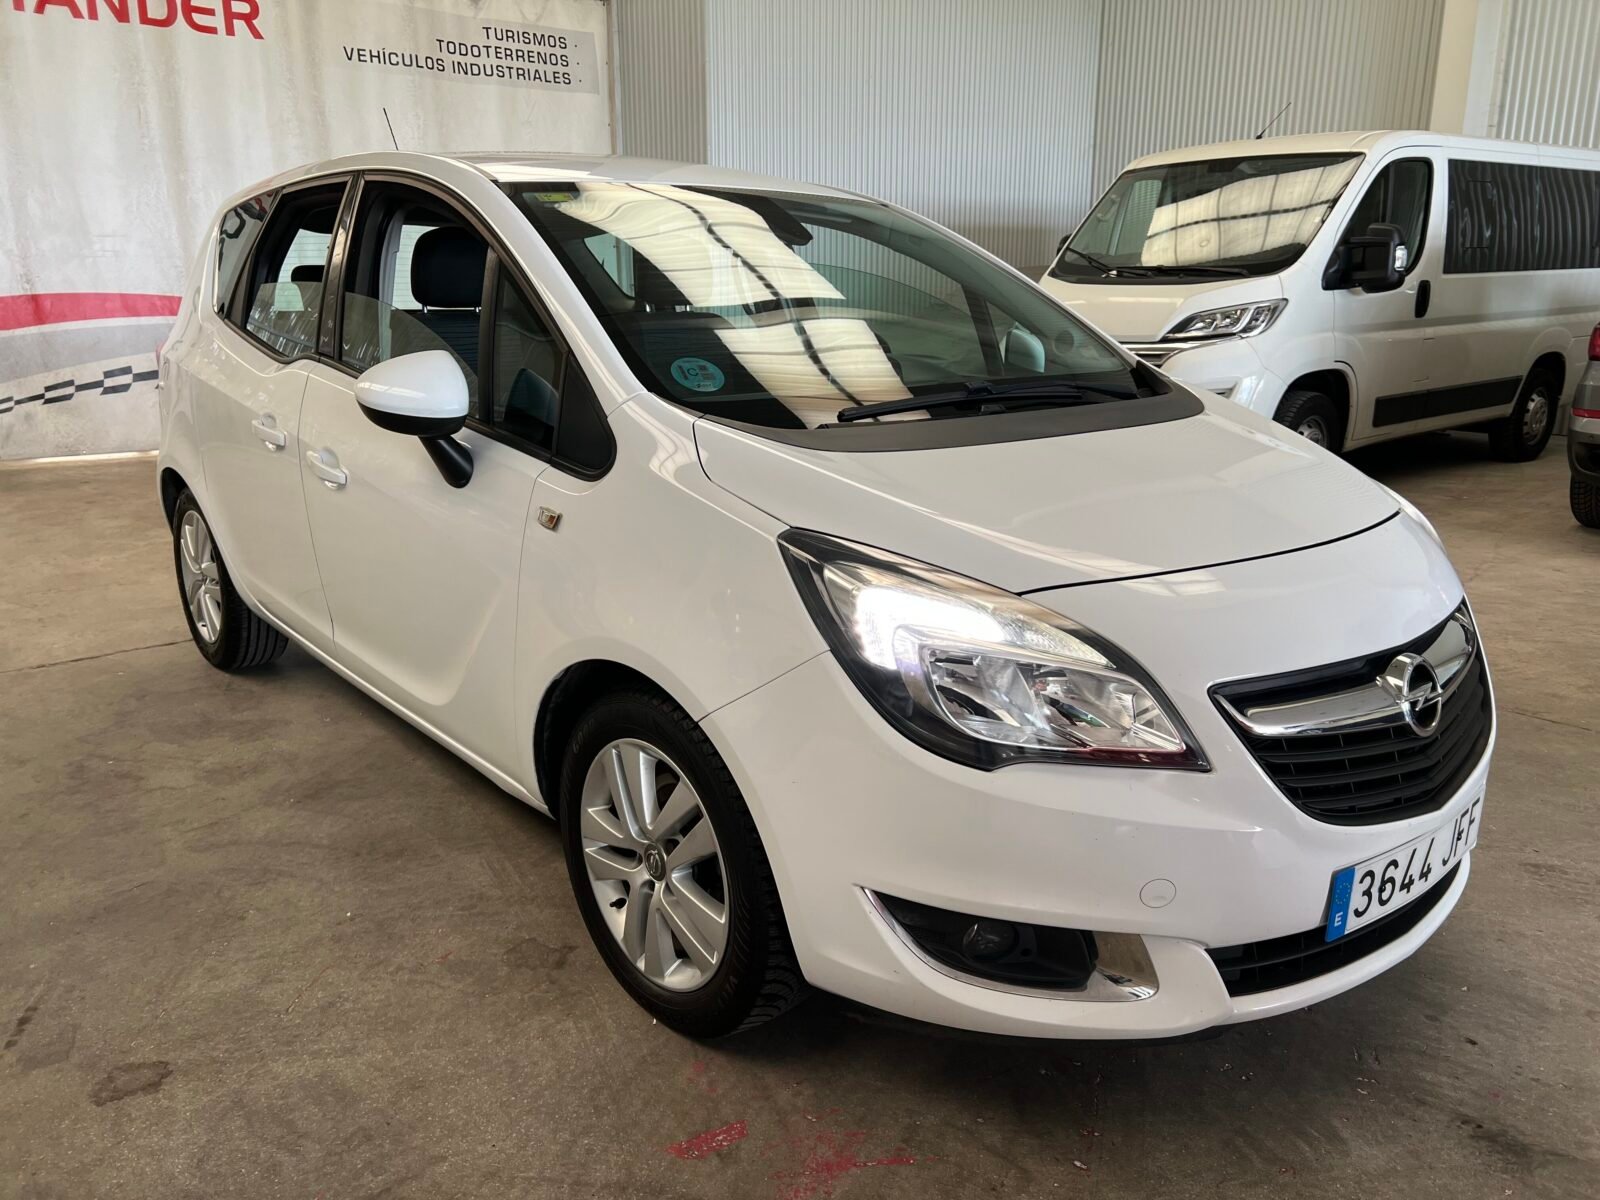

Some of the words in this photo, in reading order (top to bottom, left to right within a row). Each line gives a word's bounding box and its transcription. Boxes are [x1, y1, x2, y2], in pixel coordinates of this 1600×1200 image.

[12, 0, 265, 40] NDER
[435, 38, 570, 68] TODOTERRENOS
[482, 26, 568, 50] TURISMOS
[343, 46, 446, 72] VEHÍCULOS
[451, 60, 572, 85] INDUSTRIALES
[1353, 837, 1435, 918] 3644
[1441, 797, 1481, 867] JFF
[1333, 911, 1344, 928] E
